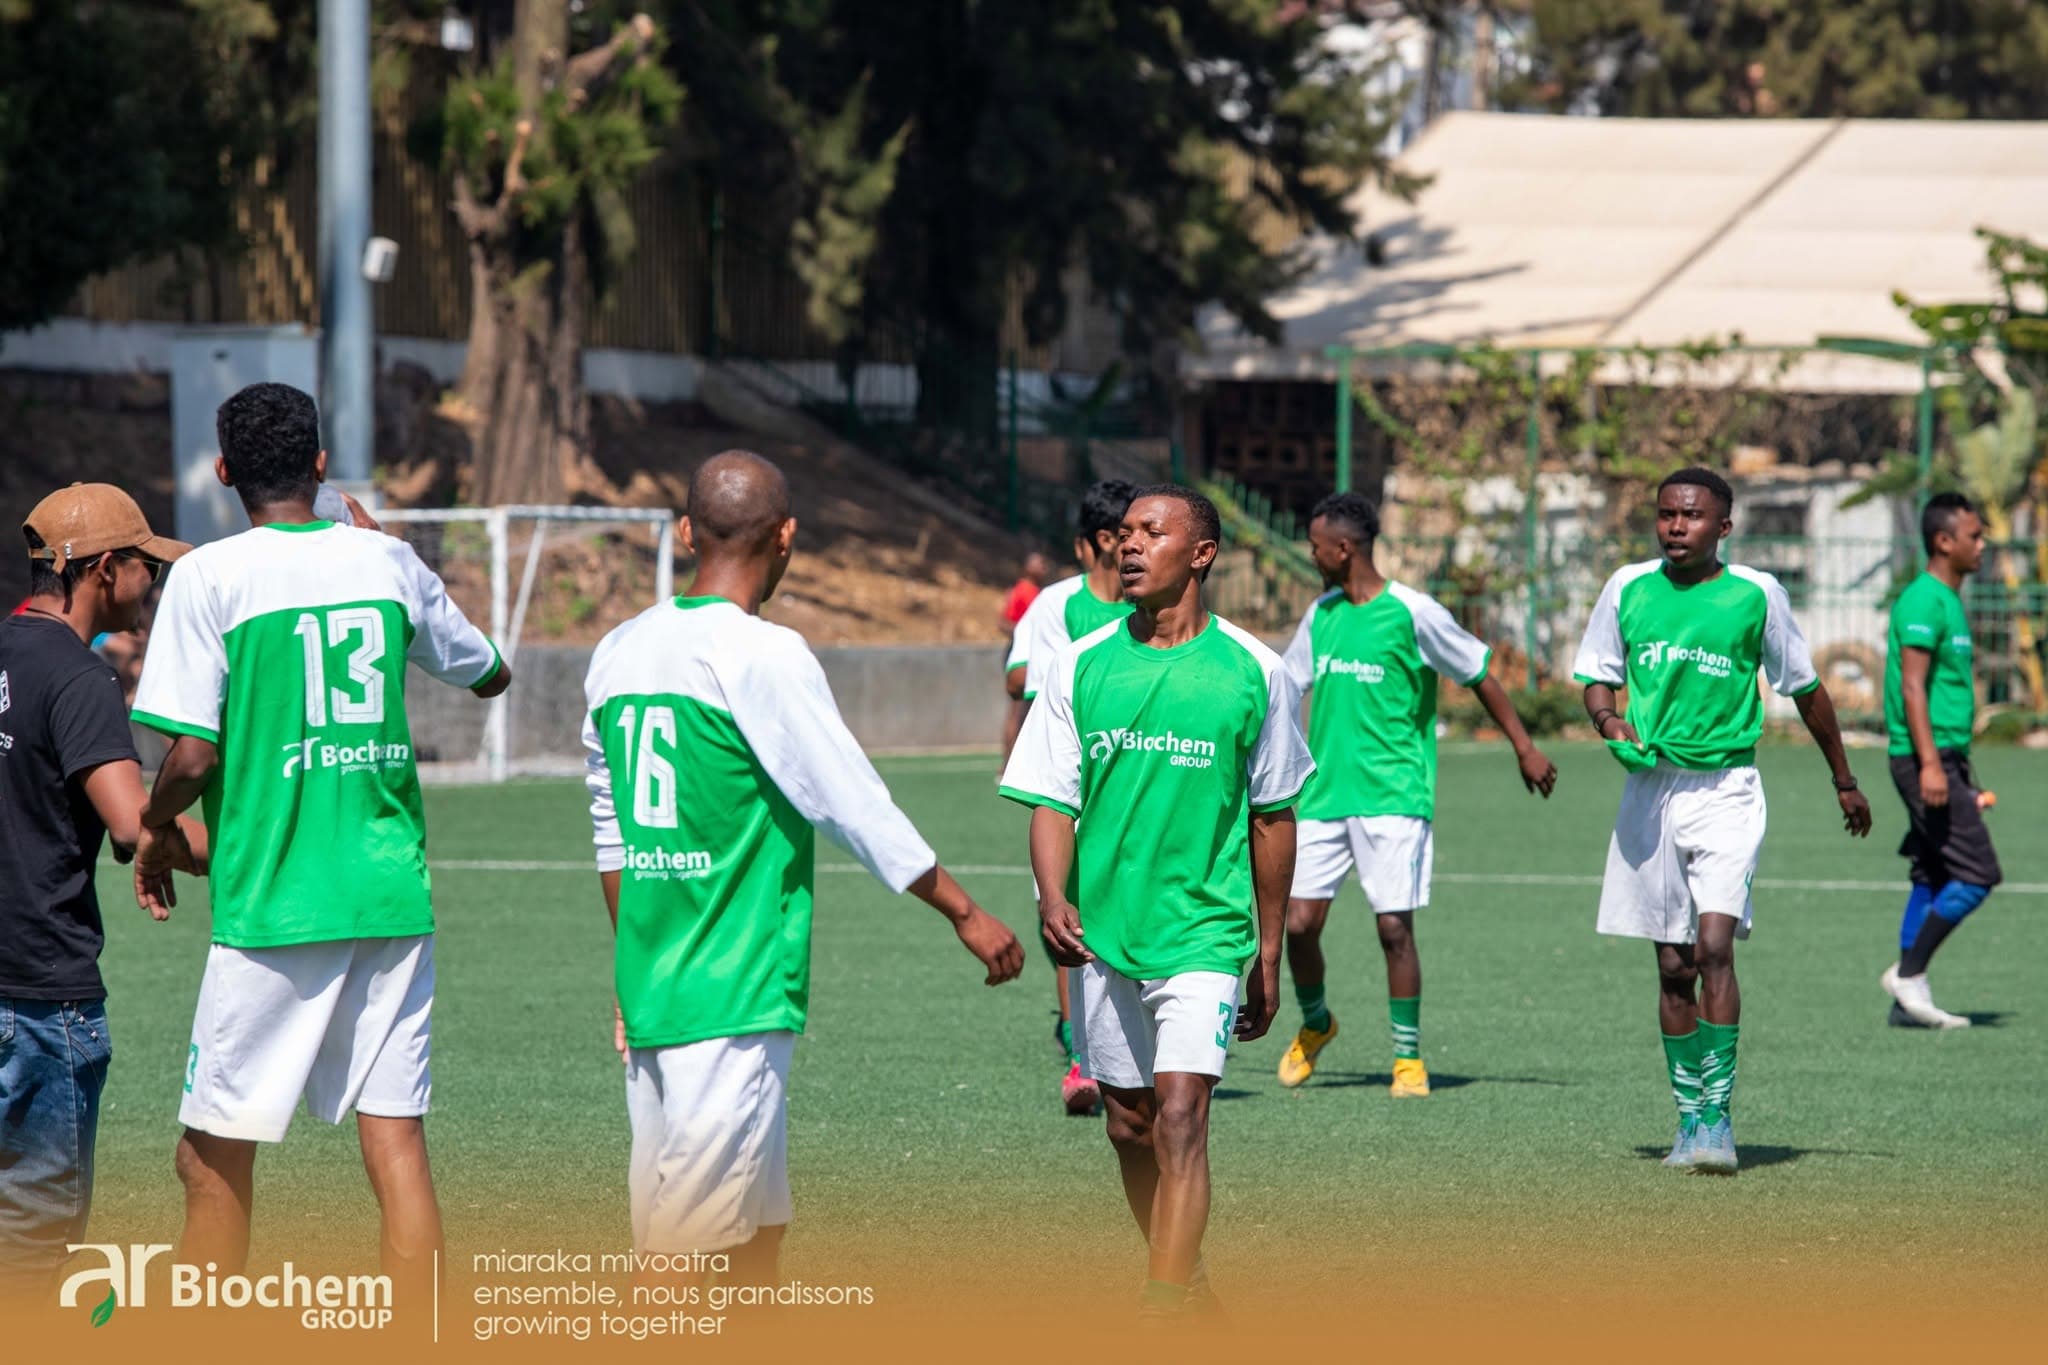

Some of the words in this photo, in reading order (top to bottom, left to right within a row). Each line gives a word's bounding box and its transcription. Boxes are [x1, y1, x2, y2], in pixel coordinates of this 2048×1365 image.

[294, 607, 386, 728] 13
[1667, 645, 1733, 669] Biochem
[1697, 663, 1731, 678] GROUP
[1122, 730, 1216, 757] Biochem
[616, 704, 679, 829] 16
[1169, 755, 1212, 769] GROUP
[622, 844, 712, 870] iochem
[1215, 1001, 1233, 1050] 3
